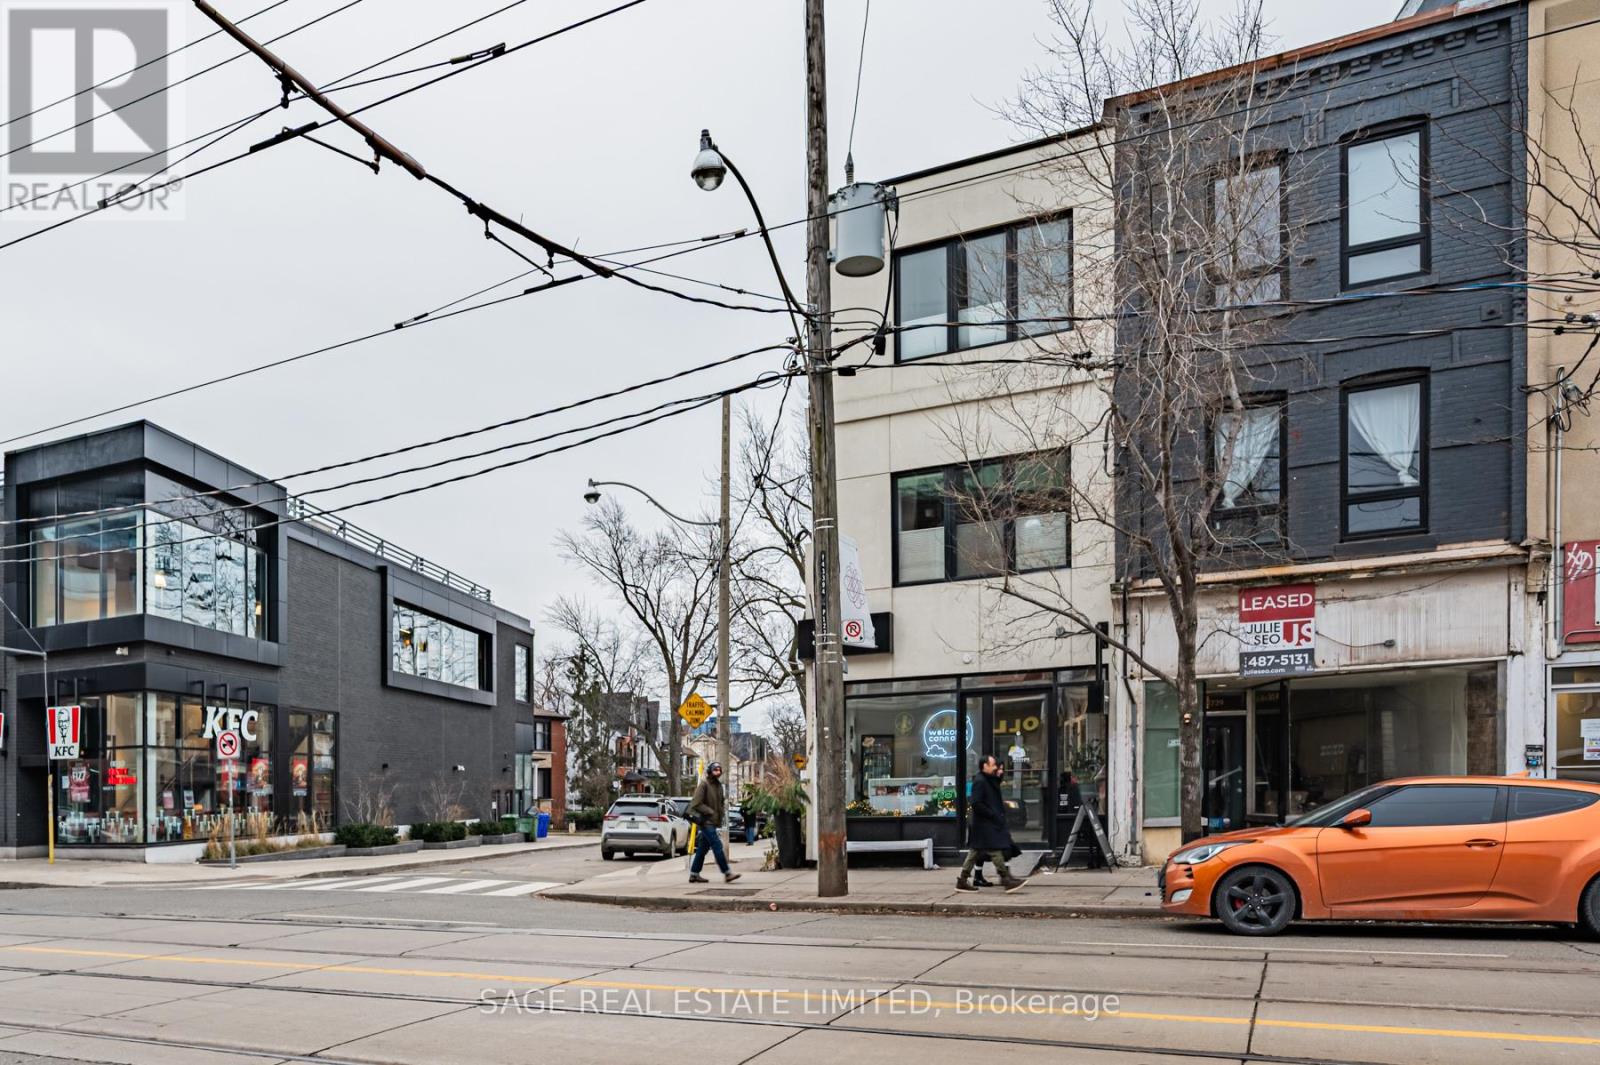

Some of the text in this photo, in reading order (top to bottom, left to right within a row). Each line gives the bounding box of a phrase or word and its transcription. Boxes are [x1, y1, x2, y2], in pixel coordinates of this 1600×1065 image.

[1241, 593, 1313, 611] LEASED
[1247, 622, 1280, 634] JULIE
[1254, 634, 1280, 645] SEO
[1248, 653, 1309, 667] 487-5131
[203, 706, 258, 741] KFC
[929, 728, 969, 736] welco
[54, 746, 75, 757] KFC
